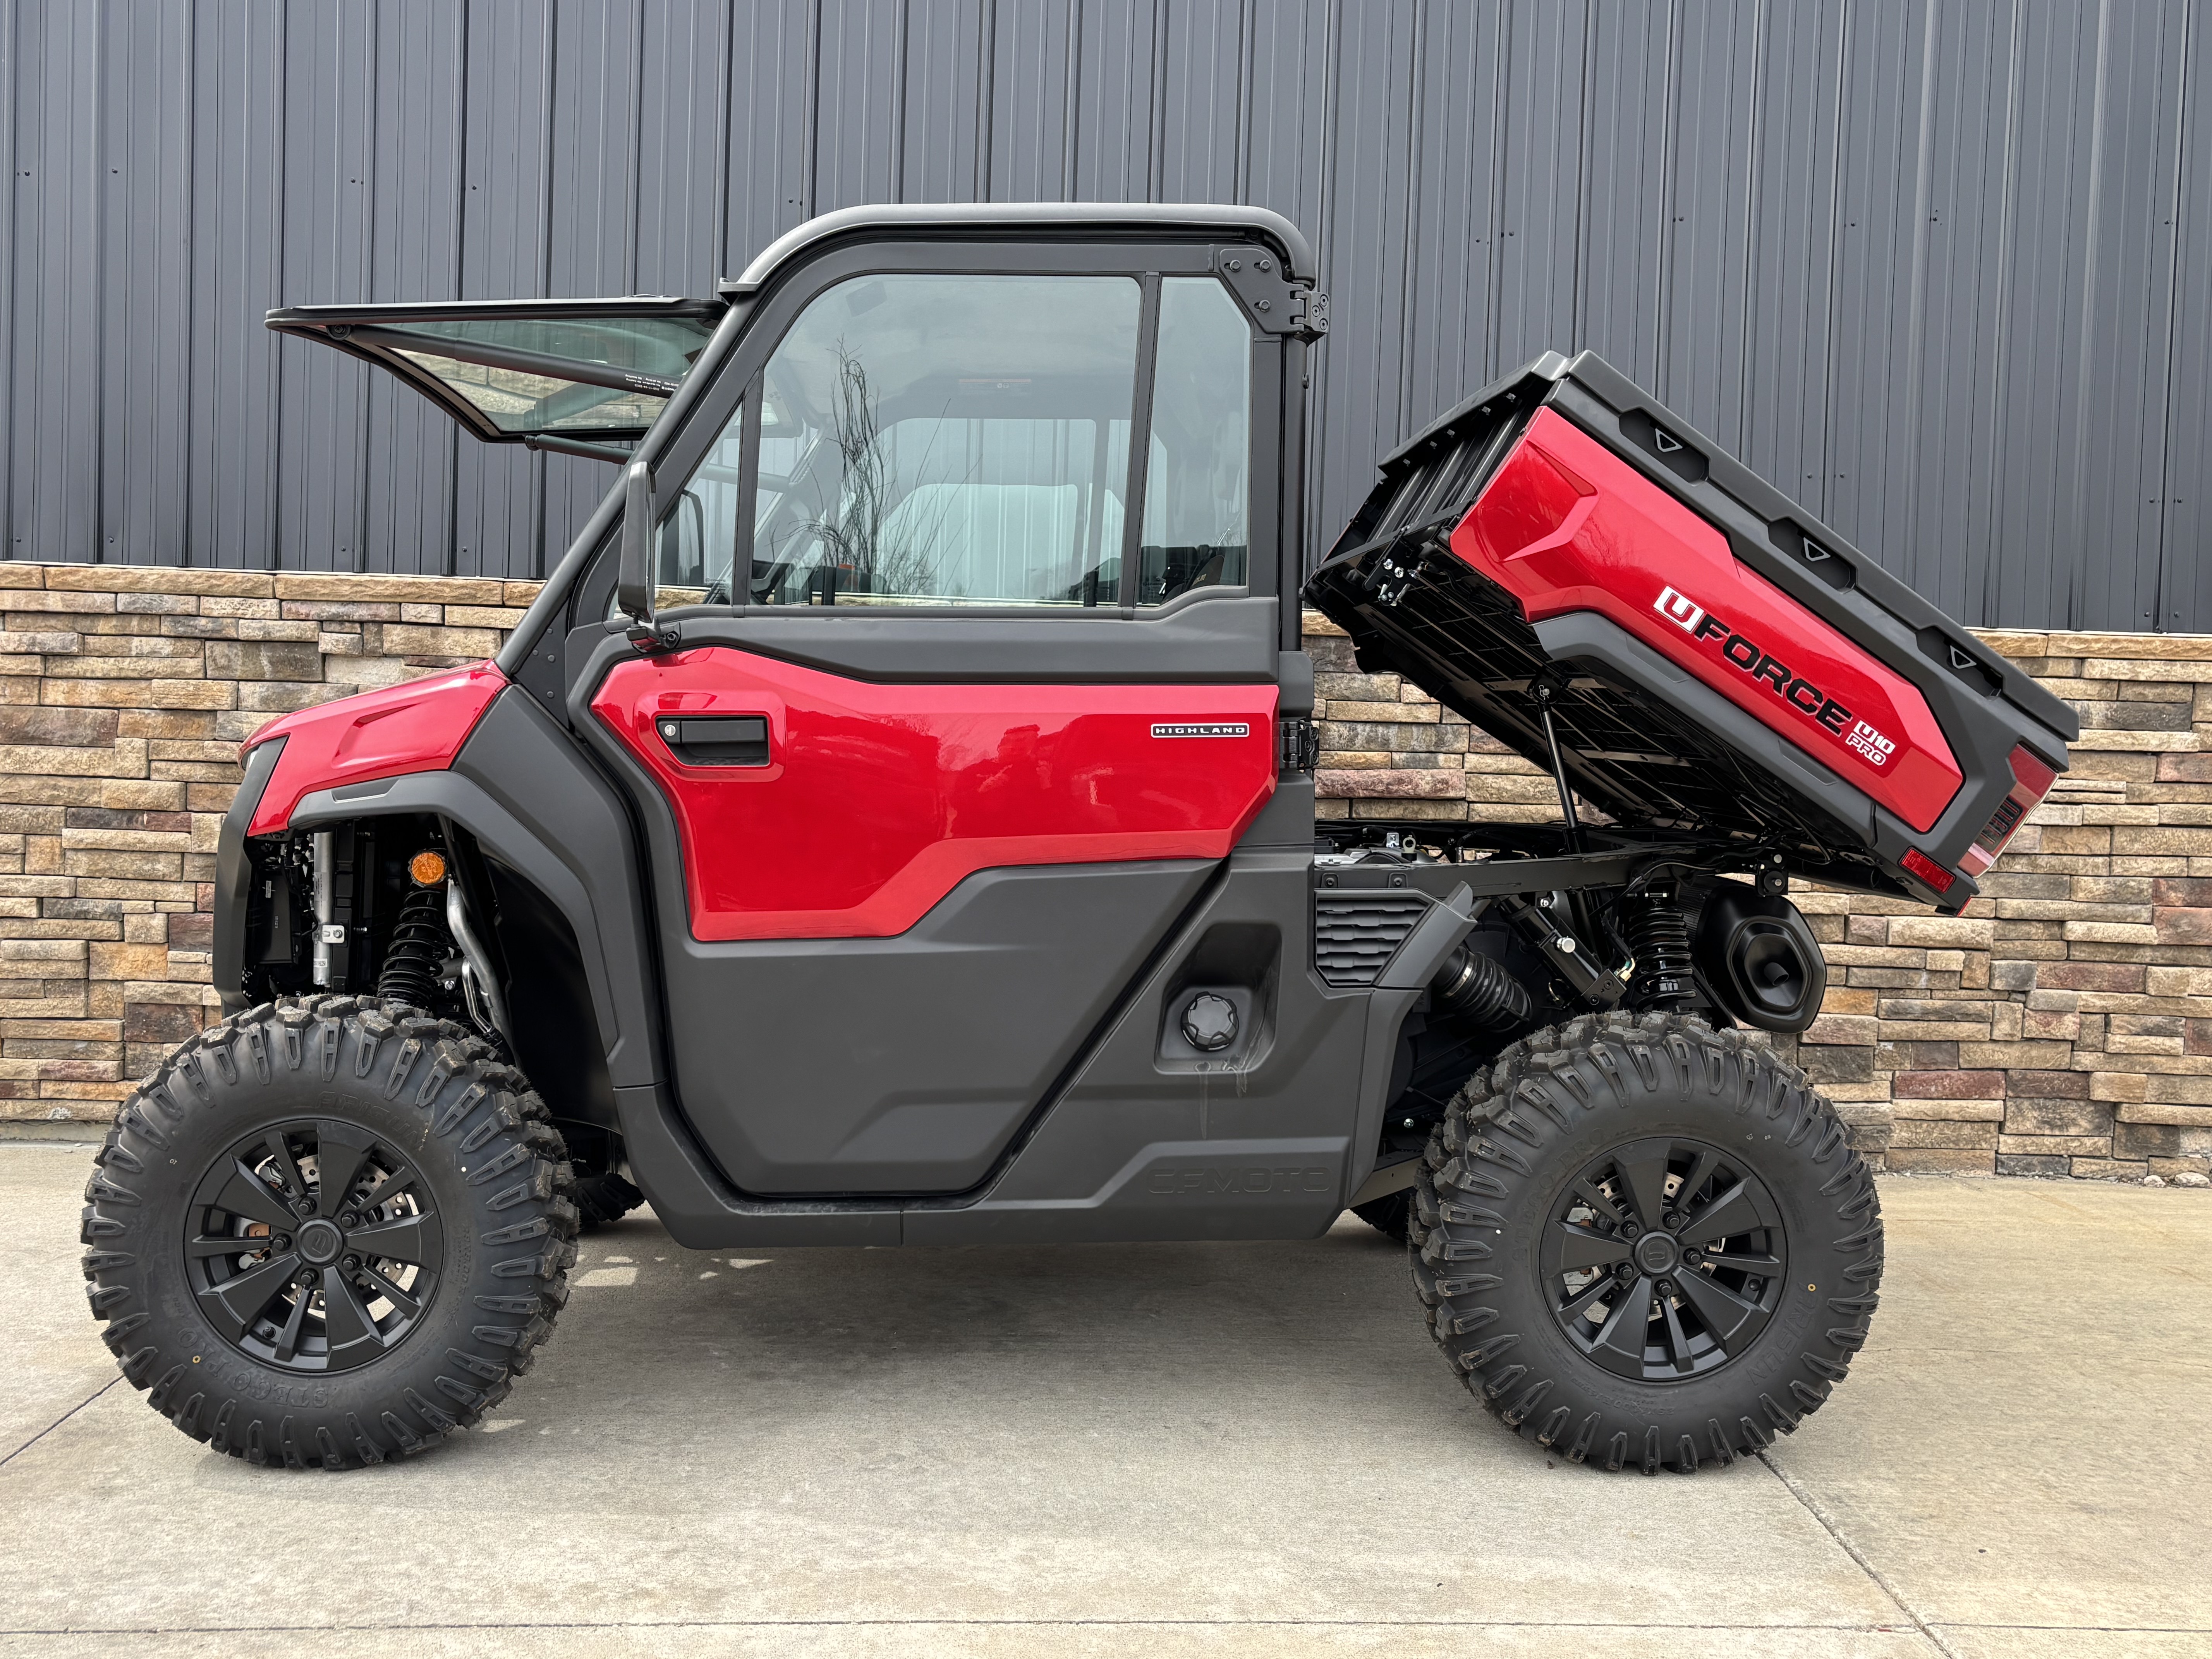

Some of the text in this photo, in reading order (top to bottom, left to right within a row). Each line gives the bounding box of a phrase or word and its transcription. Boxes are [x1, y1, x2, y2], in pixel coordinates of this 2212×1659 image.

[1845, 732, 1887, 766] PRO
[1853, 720, 1896, 754] U10
[1147, 1166, 1333, 1194] CFMOTO
[177, 1327, 328, 1408] STEGO PRO
